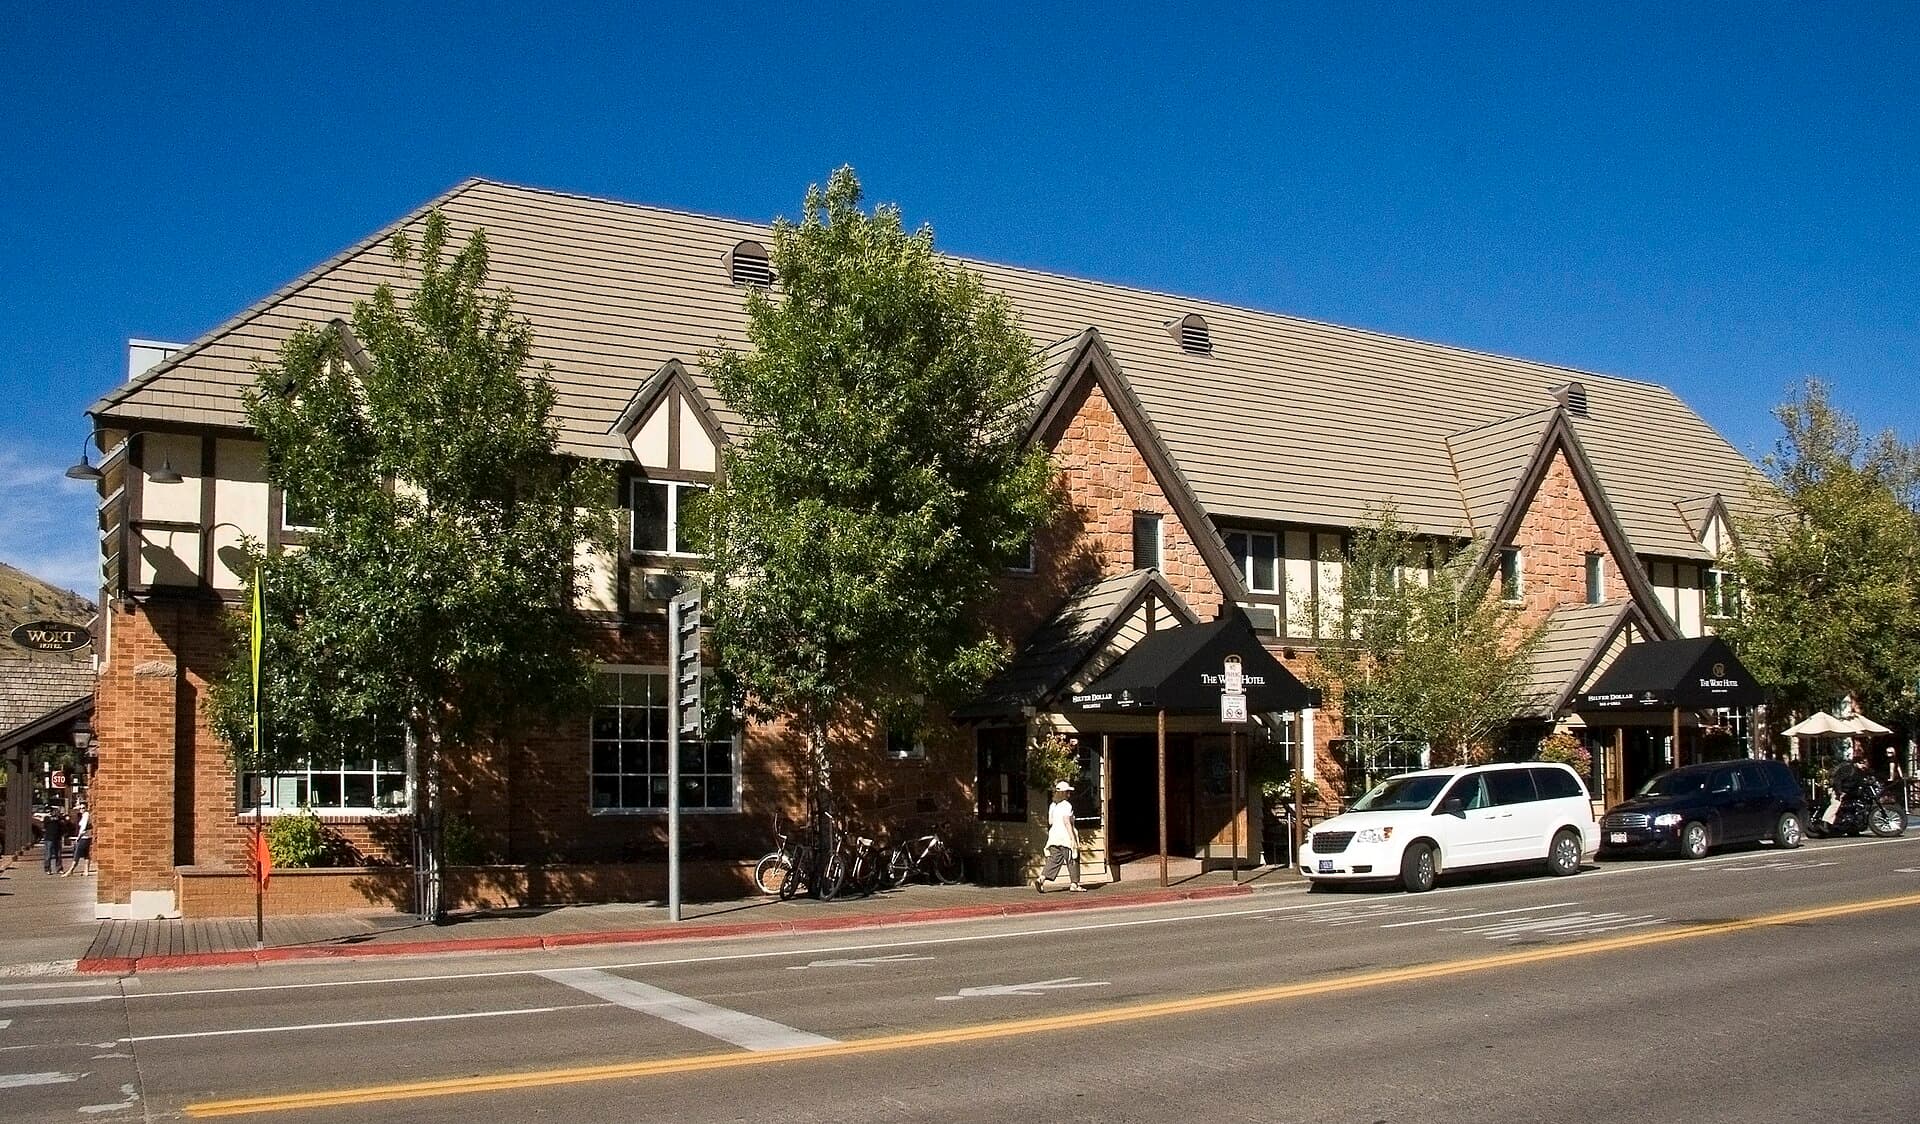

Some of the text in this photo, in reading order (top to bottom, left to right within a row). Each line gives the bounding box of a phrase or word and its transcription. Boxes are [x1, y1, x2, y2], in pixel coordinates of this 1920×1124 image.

[26, 630, 76, 643] WORT
[1201, 674, 1217, 684] THE
[1241, 675, 1265, 685] HOTEL
[1092, 693, 1113, 702] DOLLAR
[1610, 693, 1633, 701] DOLLAR
